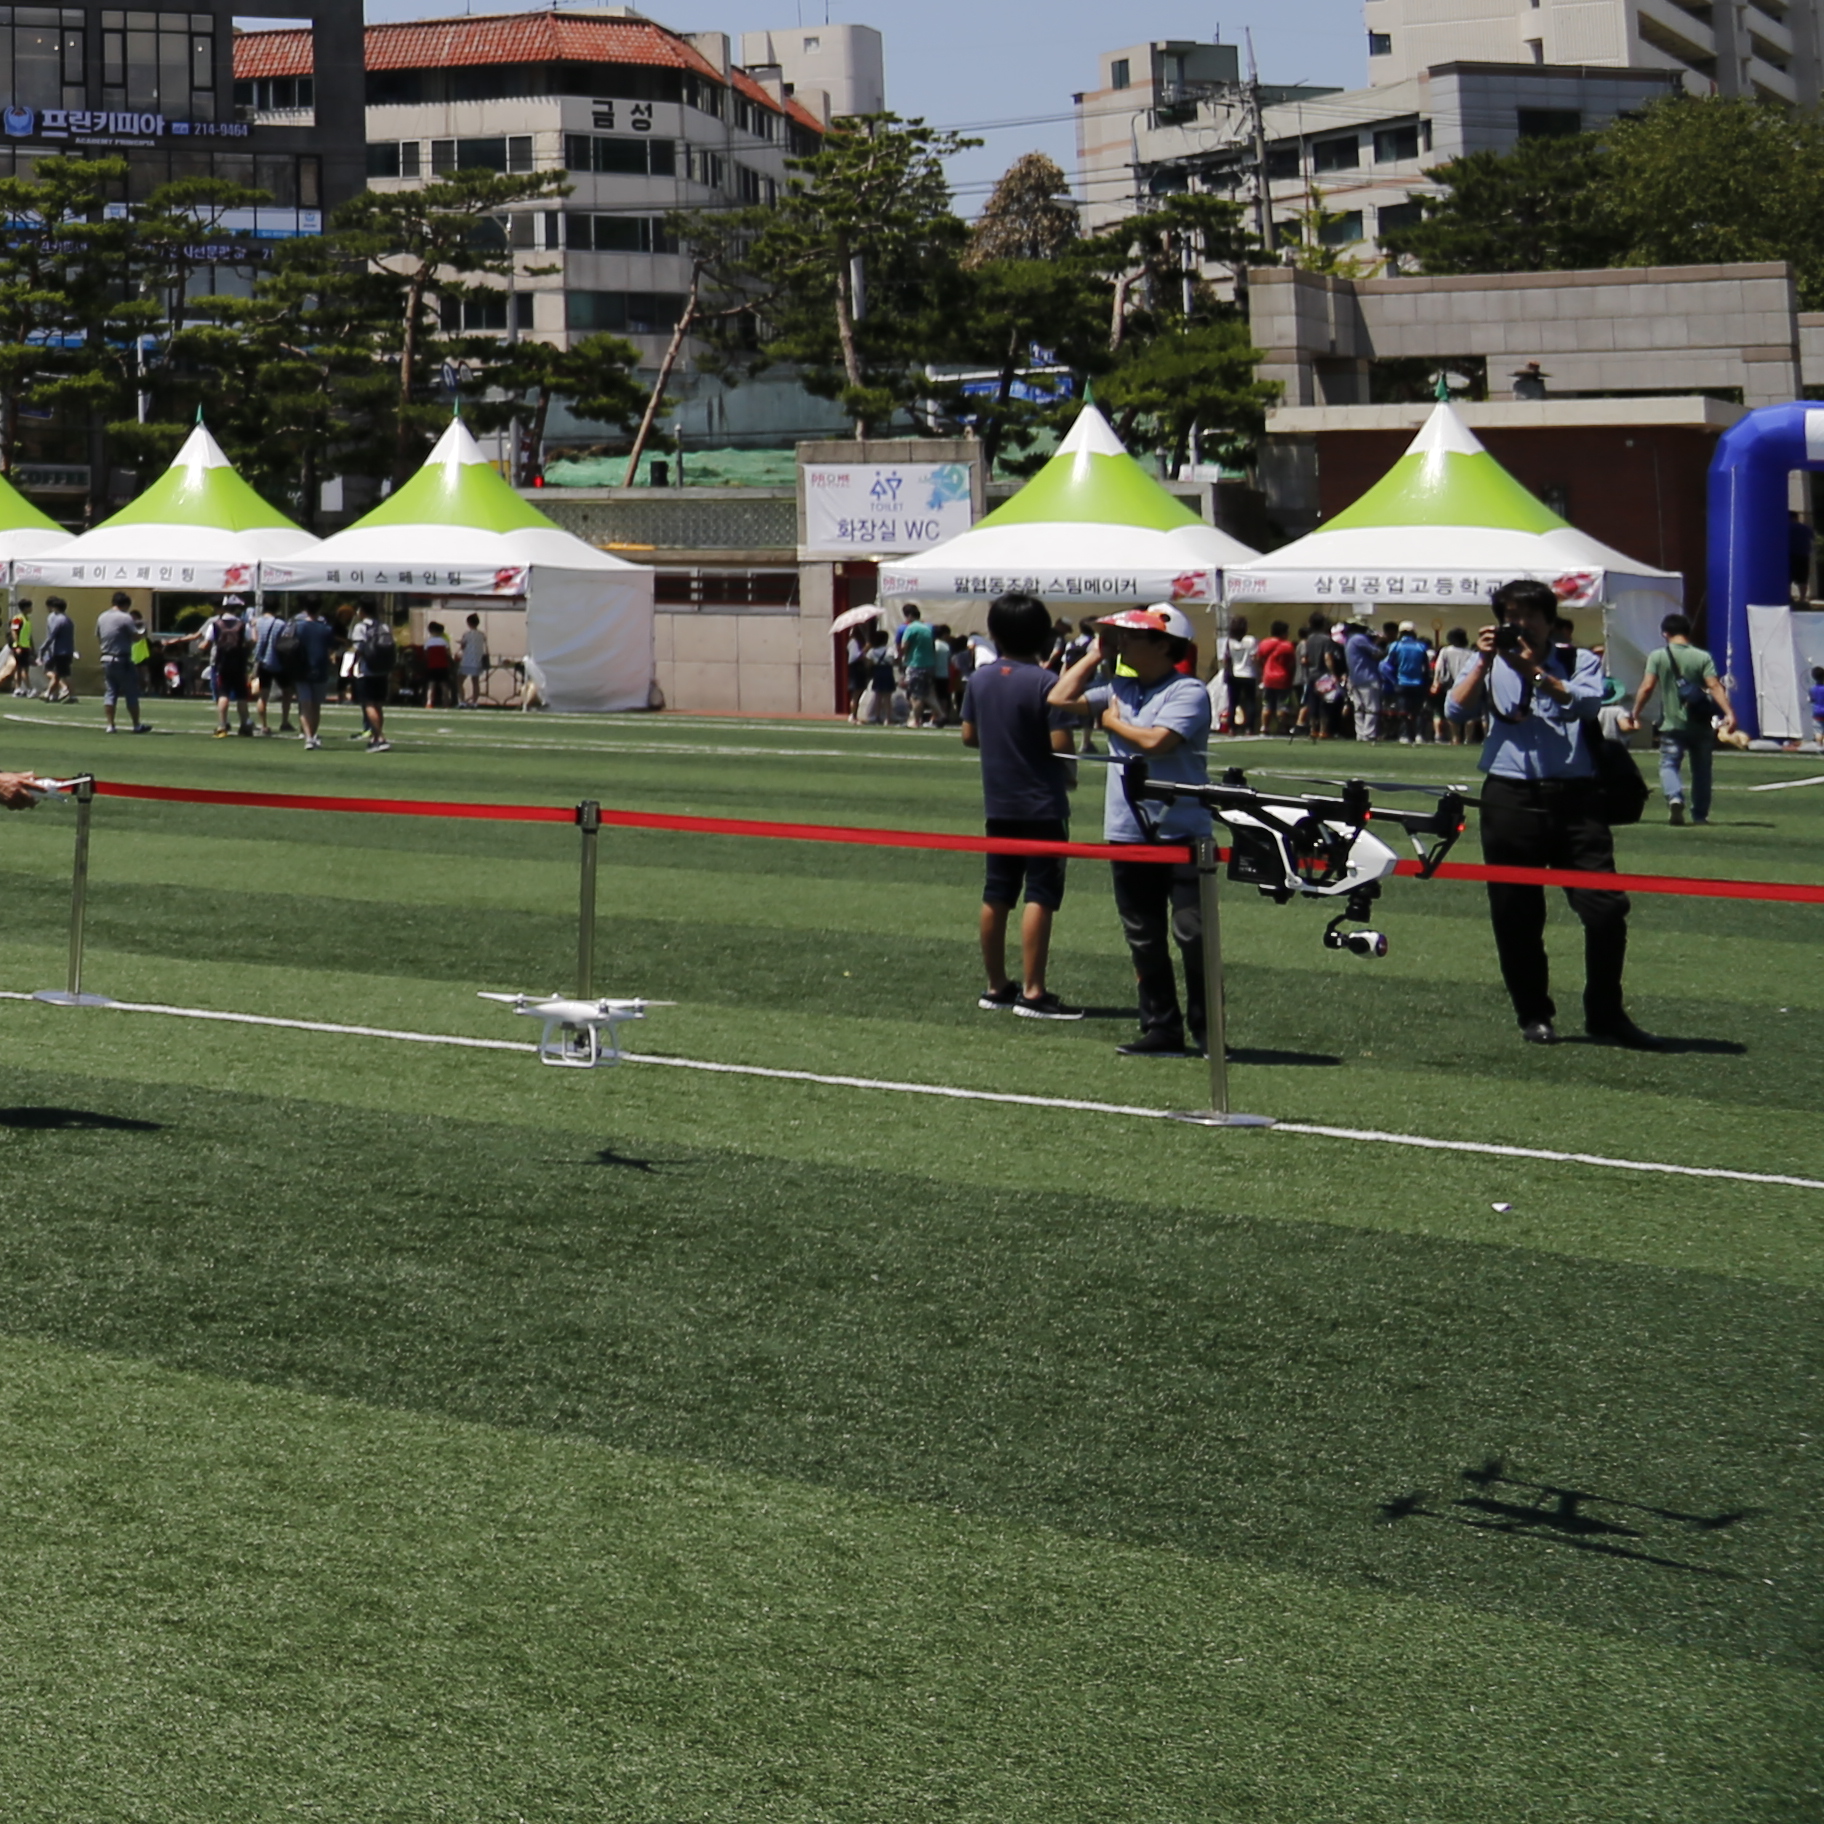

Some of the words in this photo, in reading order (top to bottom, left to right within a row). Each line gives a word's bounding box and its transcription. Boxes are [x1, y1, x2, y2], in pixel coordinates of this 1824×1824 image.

[41, 110, 166, 138] 프린키피아
[194, 124, 249, 137] 214-9464
[592, 100, 652, 131] 금성
[870, 503, 903, 512] TOILET
[838, 519, 896, 543] 화장실
[905, 520, 941, 541] WC
[71, 566, 195, 583] 페이스페인팅
[326, 570, 461, 586] 페이스페인팅
[1314, 575, 1502, 596] 삼일공업고등학교
